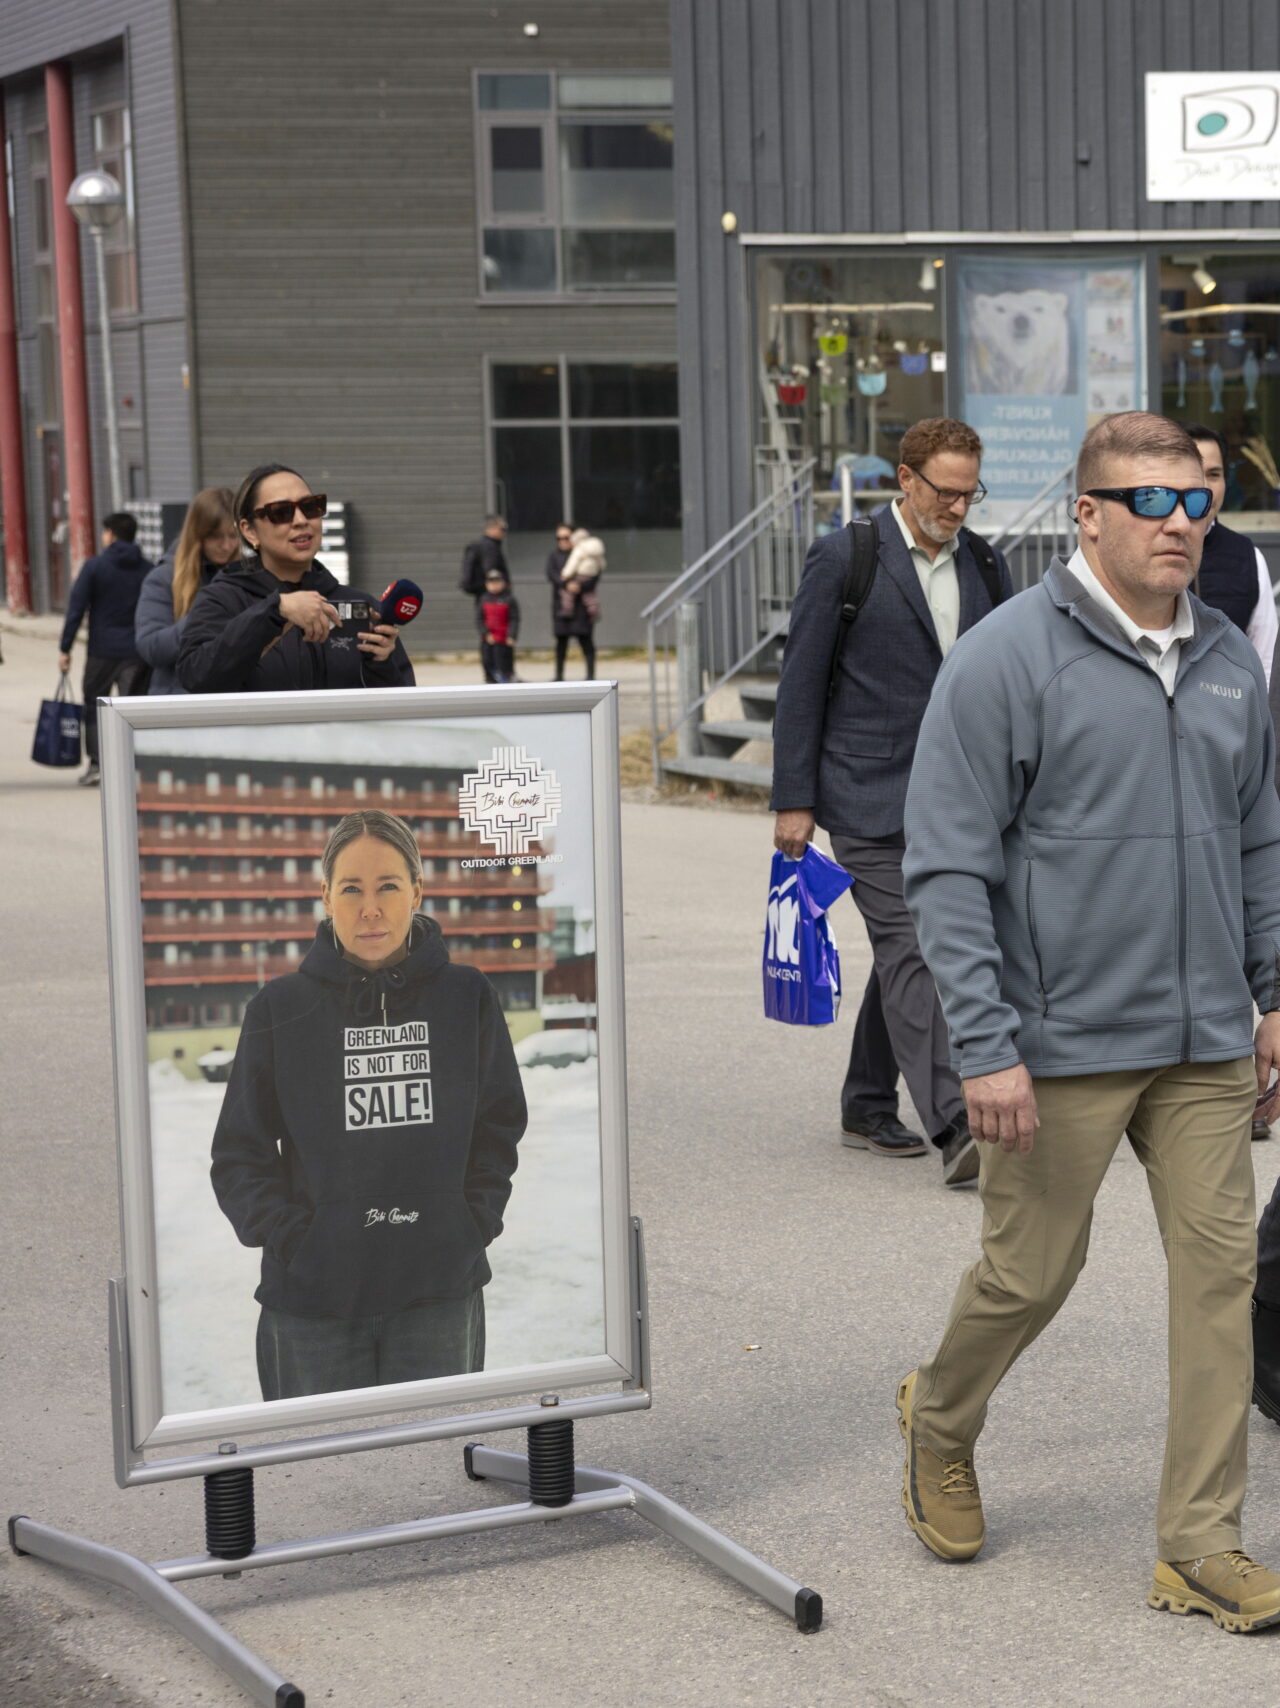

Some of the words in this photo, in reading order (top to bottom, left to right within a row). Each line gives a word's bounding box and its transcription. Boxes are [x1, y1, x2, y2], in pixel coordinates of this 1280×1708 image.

[461, 858, 506, 869] OUTDOOR
[508, 854, 564, 866] GREENLAND
[347, 1024, 427, 1048] GREENLAND
[347, 1058, 360, 1076] IS
[367, 1055, 395, 1075] NOT
[402, 1053, 428, 1072] FOR
[348, 1082, 431, 1127] SALE!
